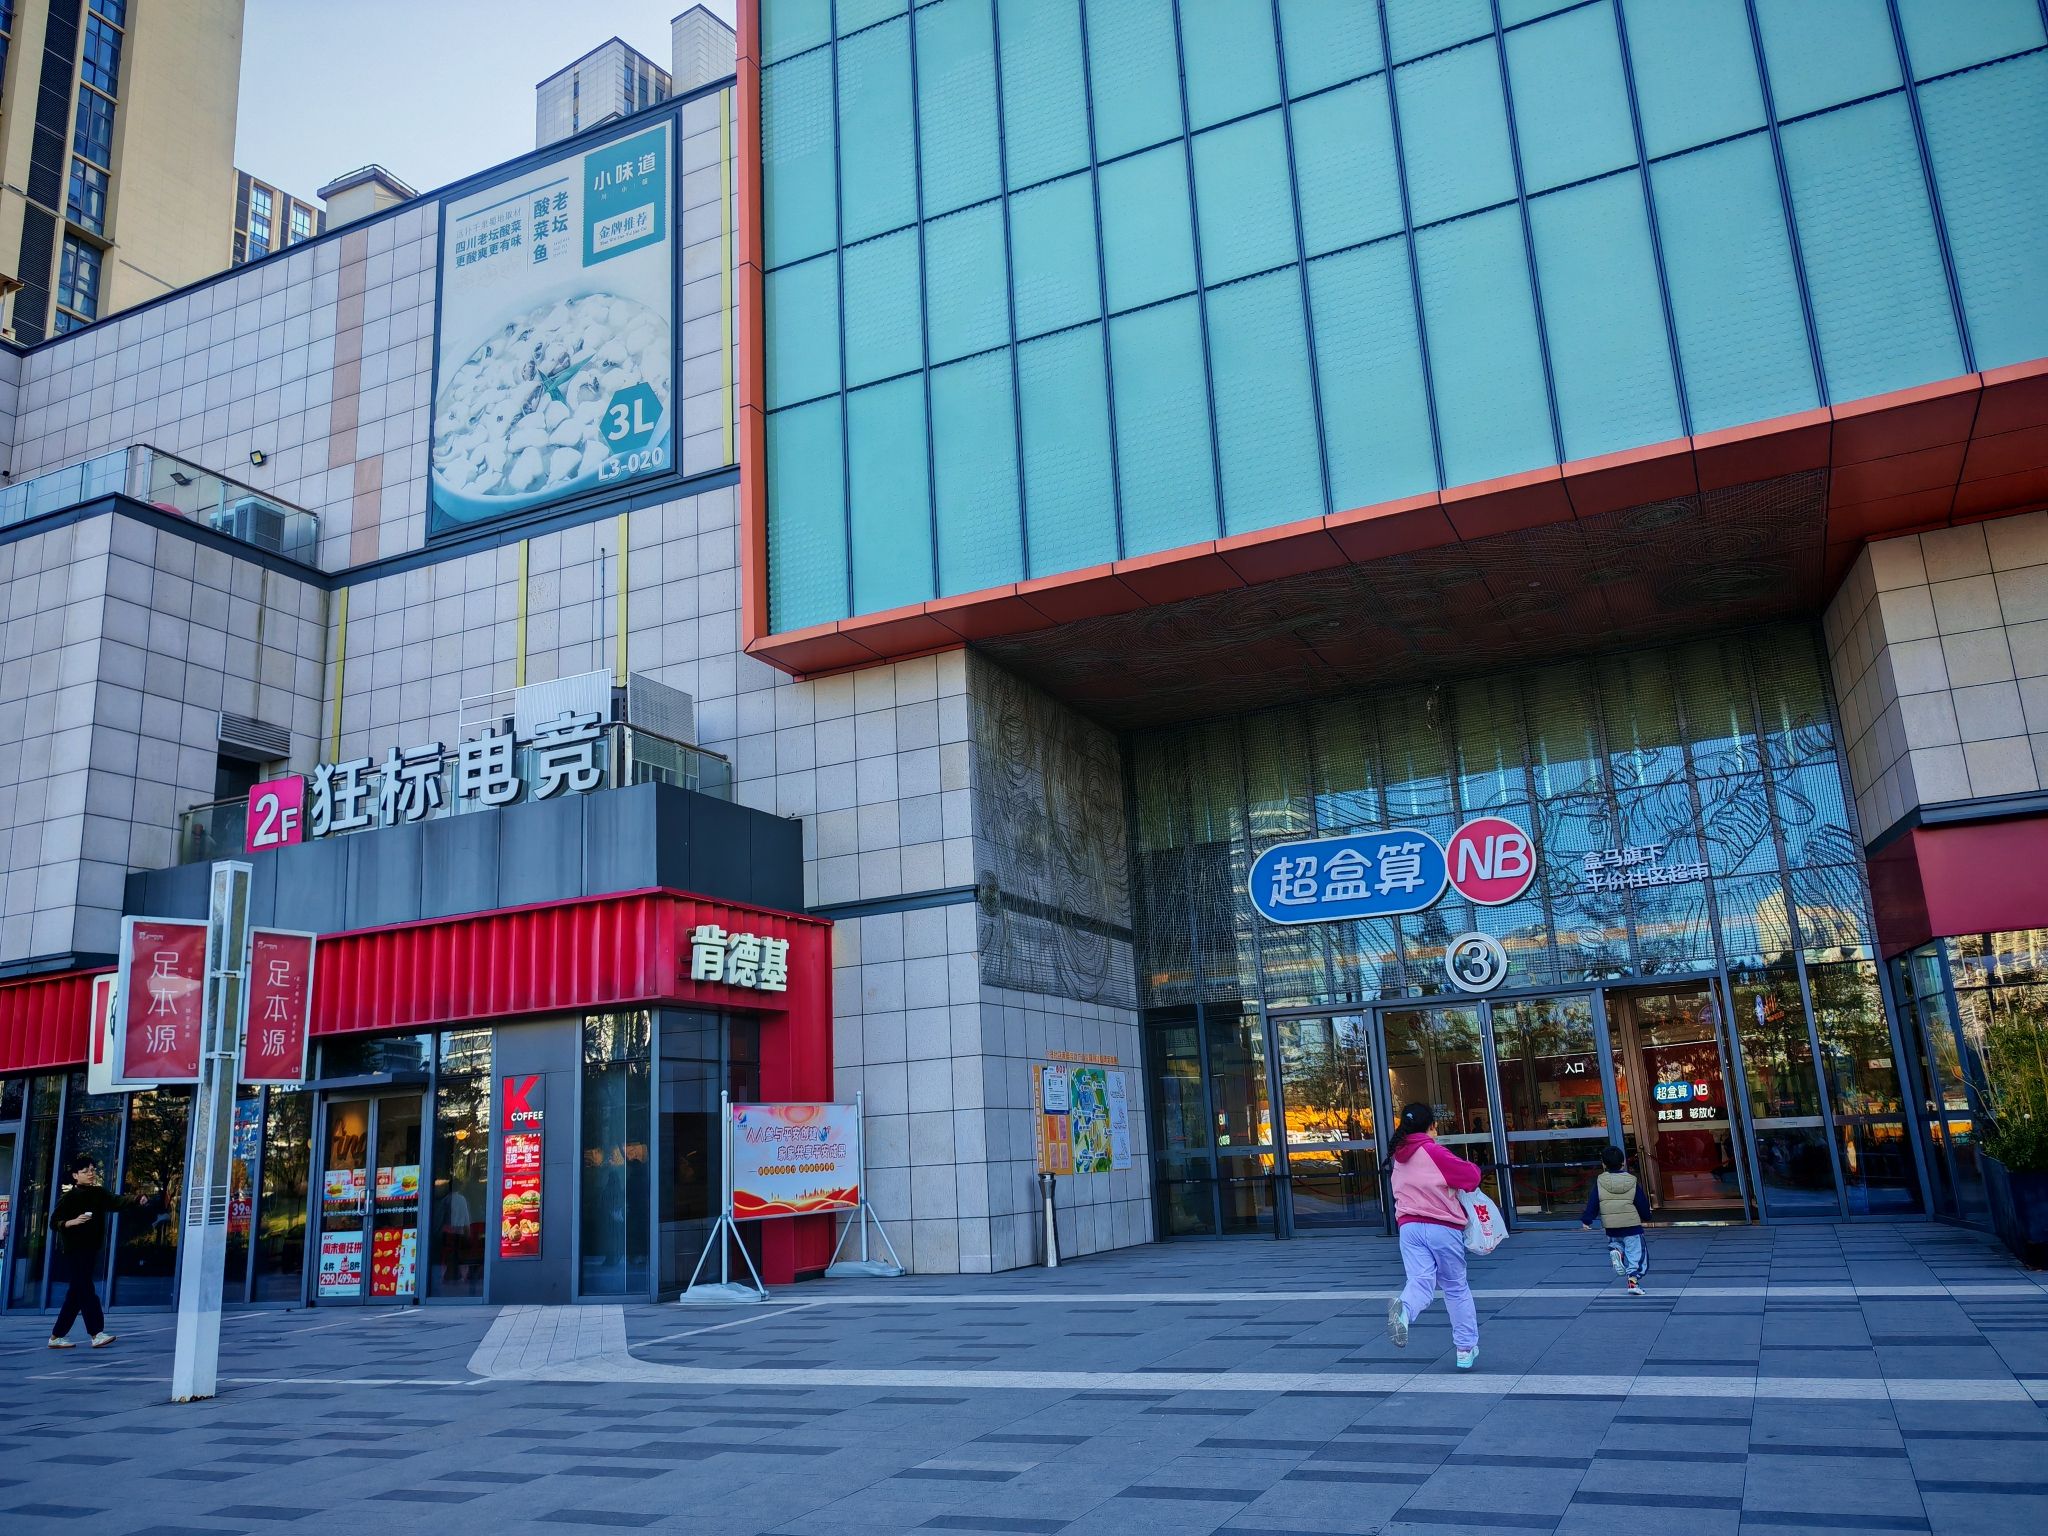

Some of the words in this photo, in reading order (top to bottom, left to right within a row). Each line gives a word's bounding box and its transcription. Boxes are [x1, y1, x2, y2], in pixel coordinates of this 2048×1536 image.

[594, 152, 656, 190] 小味道
[533, 197, 550, 260] 酸菜鱼
[552, 191, 568, 233] 老坛
[600, 211, 647, 239] 金牌推荐
[456, 220, 522, 254] 四川老坛酸菜
[456, 235, 522, 268] 更酸爽更有味
[608, 398, 655, 440] 3L
[598, 446, 664, 481] L3-020
[253, 793, 298, 847] 2F
[311, 711, 602, 836] 狂标电竞
[1269, 842, 1425, 907] 超盒算
[1457, 834, 1530, 883] NB
[1582, 843, 1664, 871] 盒马旗下
[1586, 862, 1709, 893] 平价社区超市
[691, 924, 789, 991] 肯德基
[1463, 942, 1491, 983] 3
[146, 951, 179, 1054] 足本源
[262, 960, 290, 1056] 足本源
[1565, 1063, 1585, 1074] 入口
[503, 1075, 541, 1130] K
[1657, 1085, 1688, 1100] 超盒算
[1693, 1084, 1708, 1097] NB
[511, 1111, 543, 1121] COFFEE
[1689, 1107, 1715, 1118] 够放心
[777, 1144, 847, 1161] 家家共享平安成果
